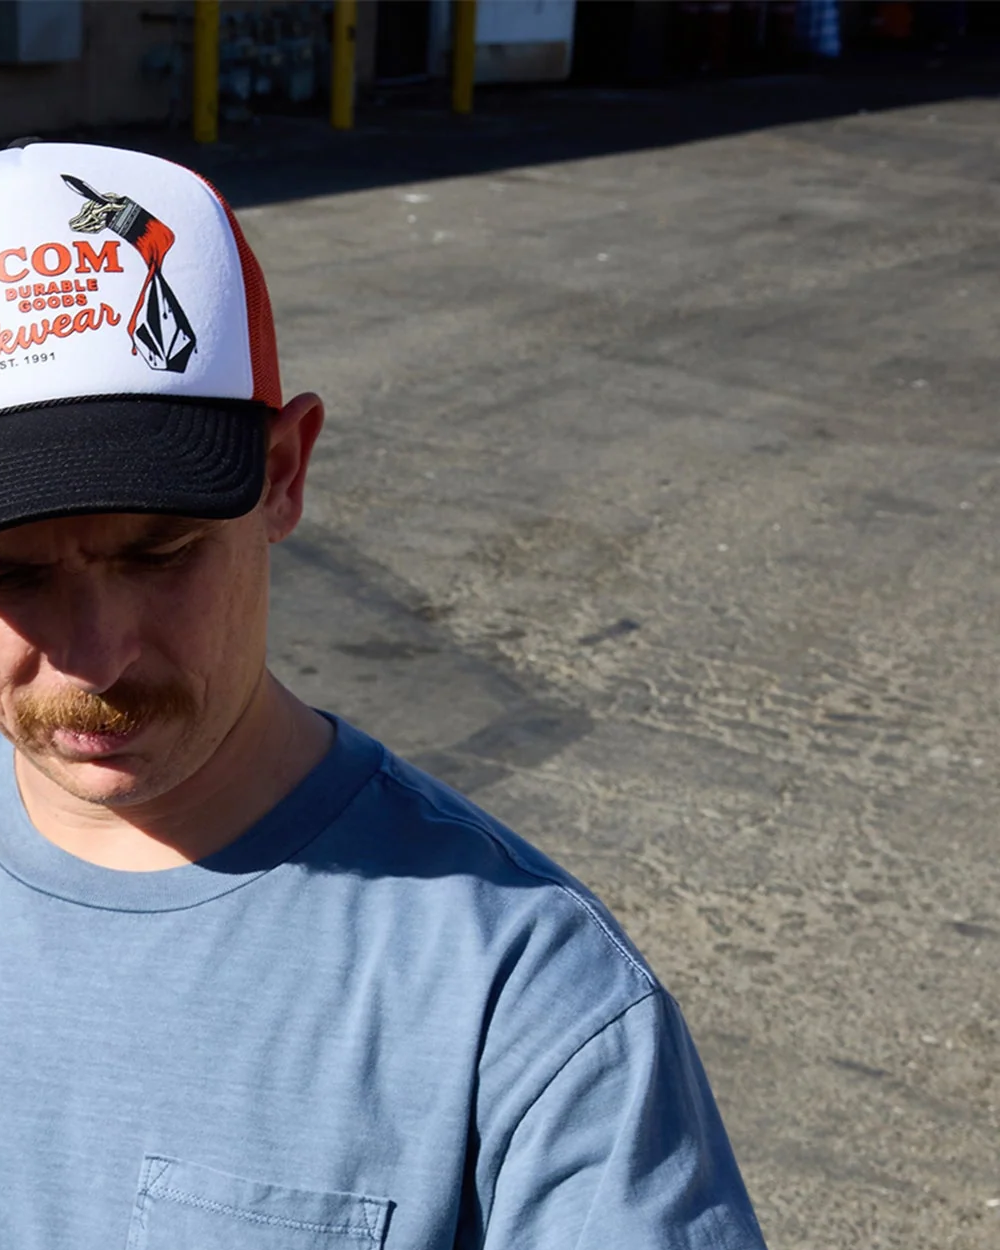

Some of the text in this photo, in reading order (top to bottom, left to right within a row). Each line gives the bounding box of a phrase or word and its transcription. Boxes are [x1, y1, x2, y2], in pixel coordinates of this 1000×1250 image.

[5, 278, 98, 302] DURABLE
[18, 293, 88, 313] GOODS
[23, 351, 56, 365] 1991
